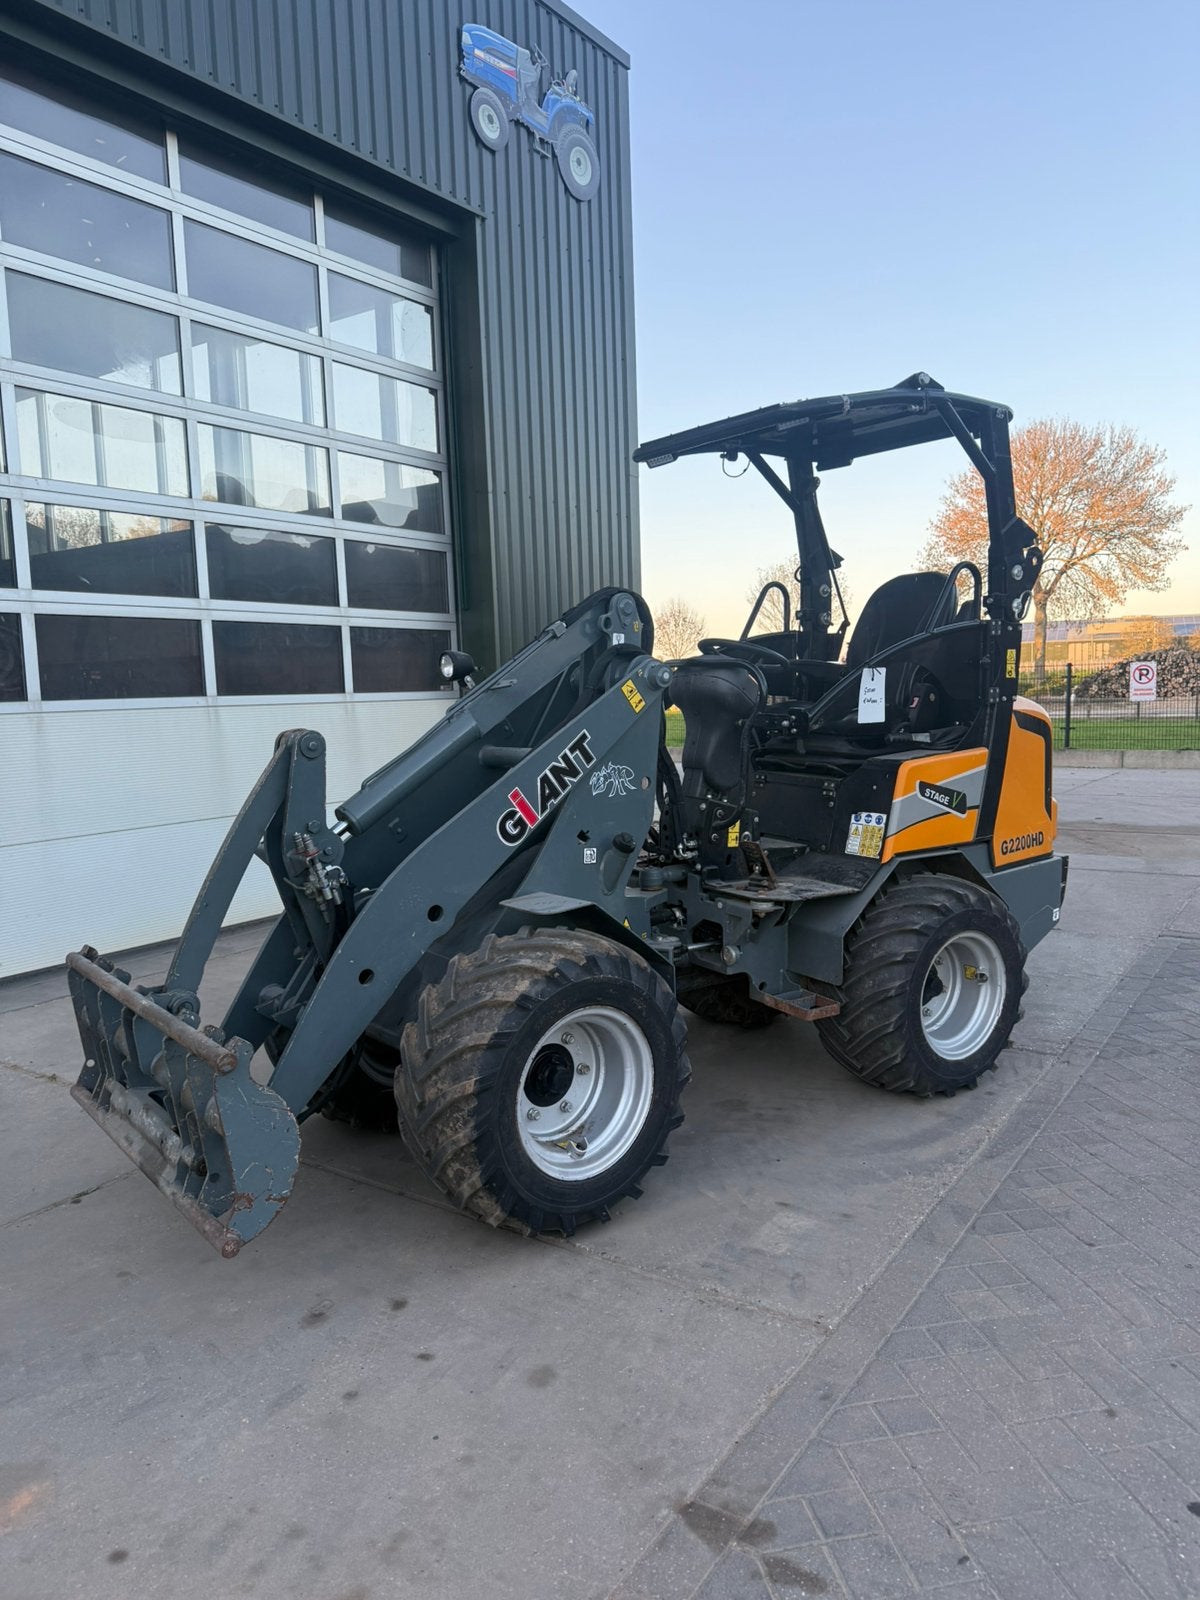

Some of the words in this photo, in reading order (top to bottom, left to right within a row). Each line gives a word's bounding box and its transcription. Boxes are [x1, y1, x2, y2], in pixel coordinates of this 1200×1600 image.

[924, 788, 950, 805] STAGE
[952, 791, 965, 808] V
[1001, 831, 1044, 856] G2200HD
